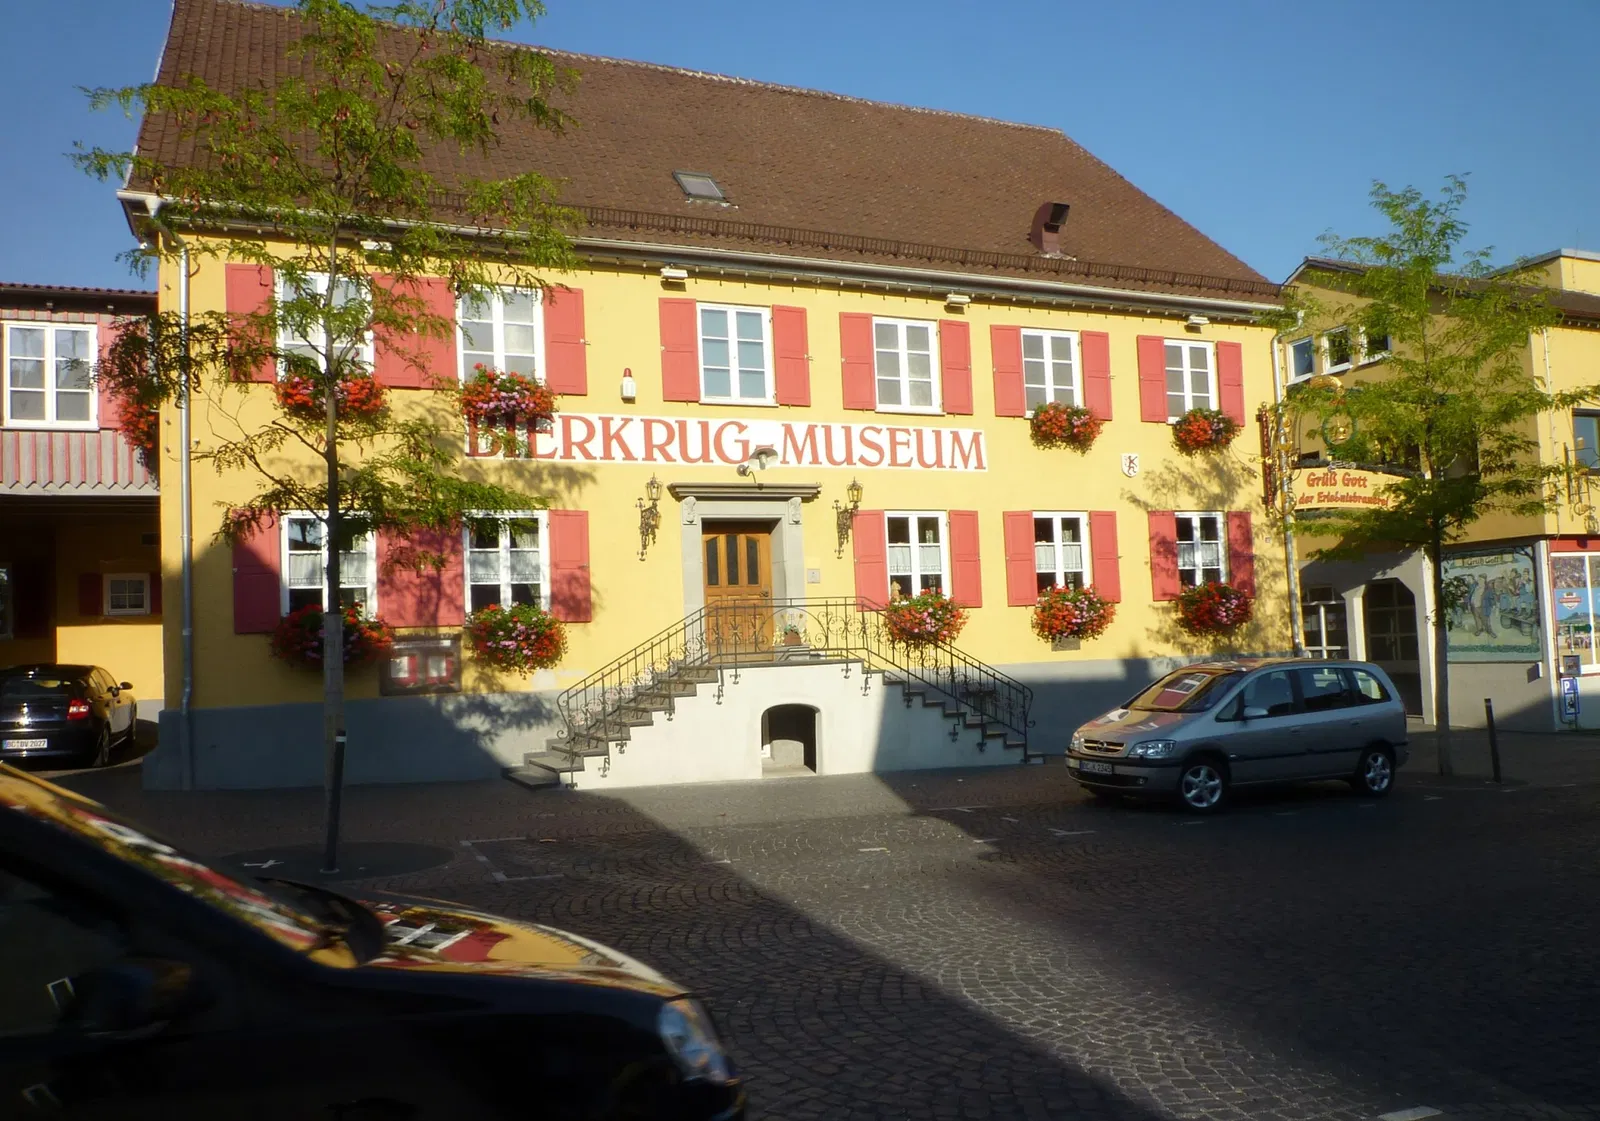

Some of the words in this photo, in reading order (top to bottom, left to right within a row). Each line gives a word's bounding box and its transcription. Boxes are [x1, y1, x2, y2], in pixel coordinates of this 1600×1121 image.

[1306, 472, 1338, 488] Grüß
[1342, 472, 1368, 488] Gott
[1298, 492, 1314, 505] der
[1564, 681, 1570, 692] P
